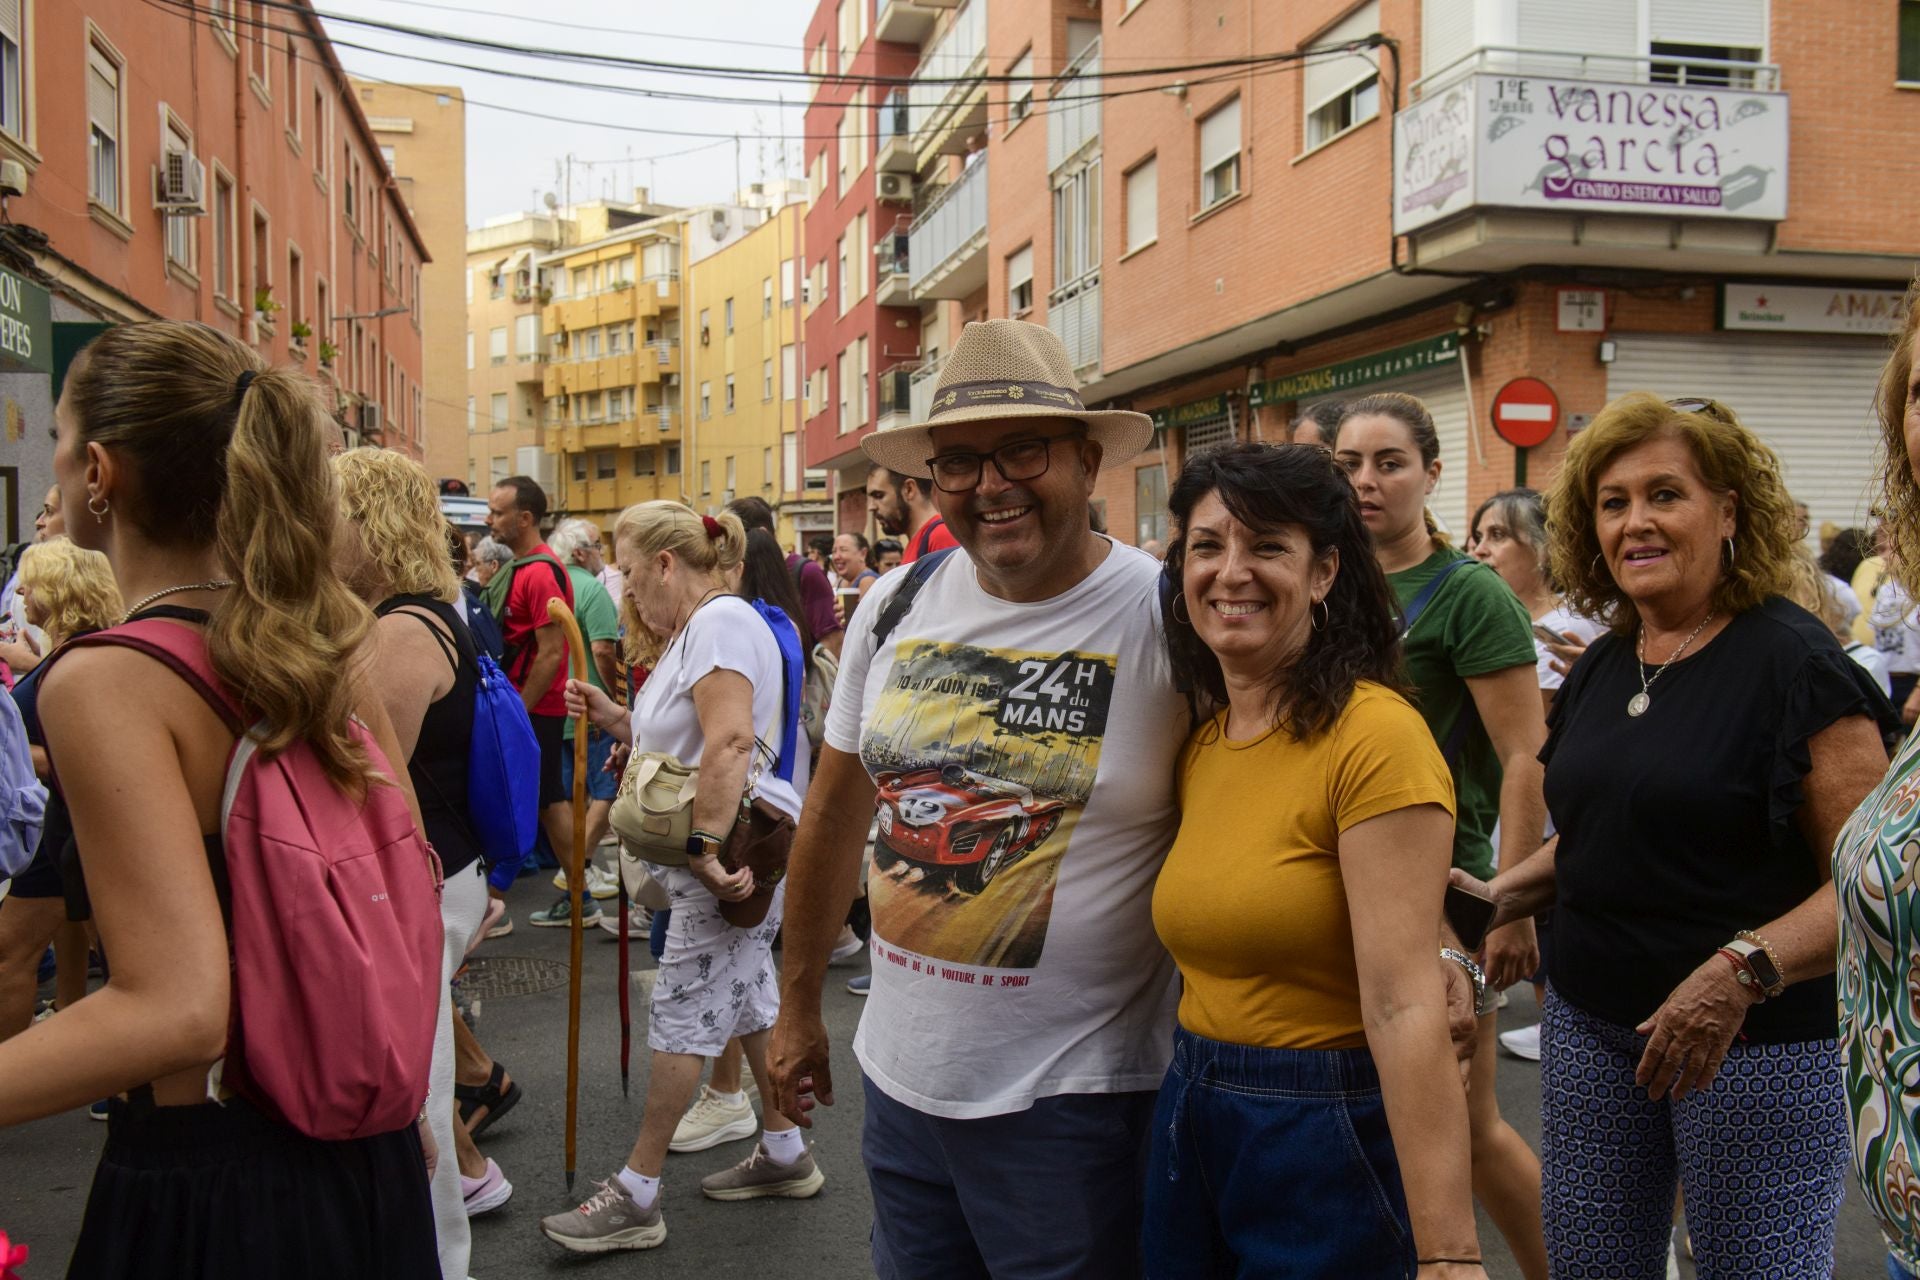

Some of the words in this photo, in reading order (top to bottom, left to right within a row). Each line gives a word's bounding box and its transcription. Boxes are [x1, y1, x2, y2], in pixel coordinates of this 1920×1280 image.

[1571, 180, 1621, 200] CENTRO
[1621, 183, 1671, 202] ESTETICA
[1671, 186, 1682, 203] Y
[1682, 187, 1721, 205] SALUD
[1332, 350, 1434, 387] RESTAURANTE
[896, 675, 910, 690] 10
[933, 678, 968, 696] JUIN
[1008, 661, 1071, 703] 24
[1074, 663, 1097, 686] H
[1070, 690, 1090, 708] du
[1002, 703, 1086, 733] MANS
[887, 950, 907, 967] MONDE
[912, 960, 921, 972] DE
[926, 964, 935, 976] LA
[942, 967, 976, 984] VOITURE
[982, 974, 994, 986] DE
[1001, 975, 1031, 987] SPORT
